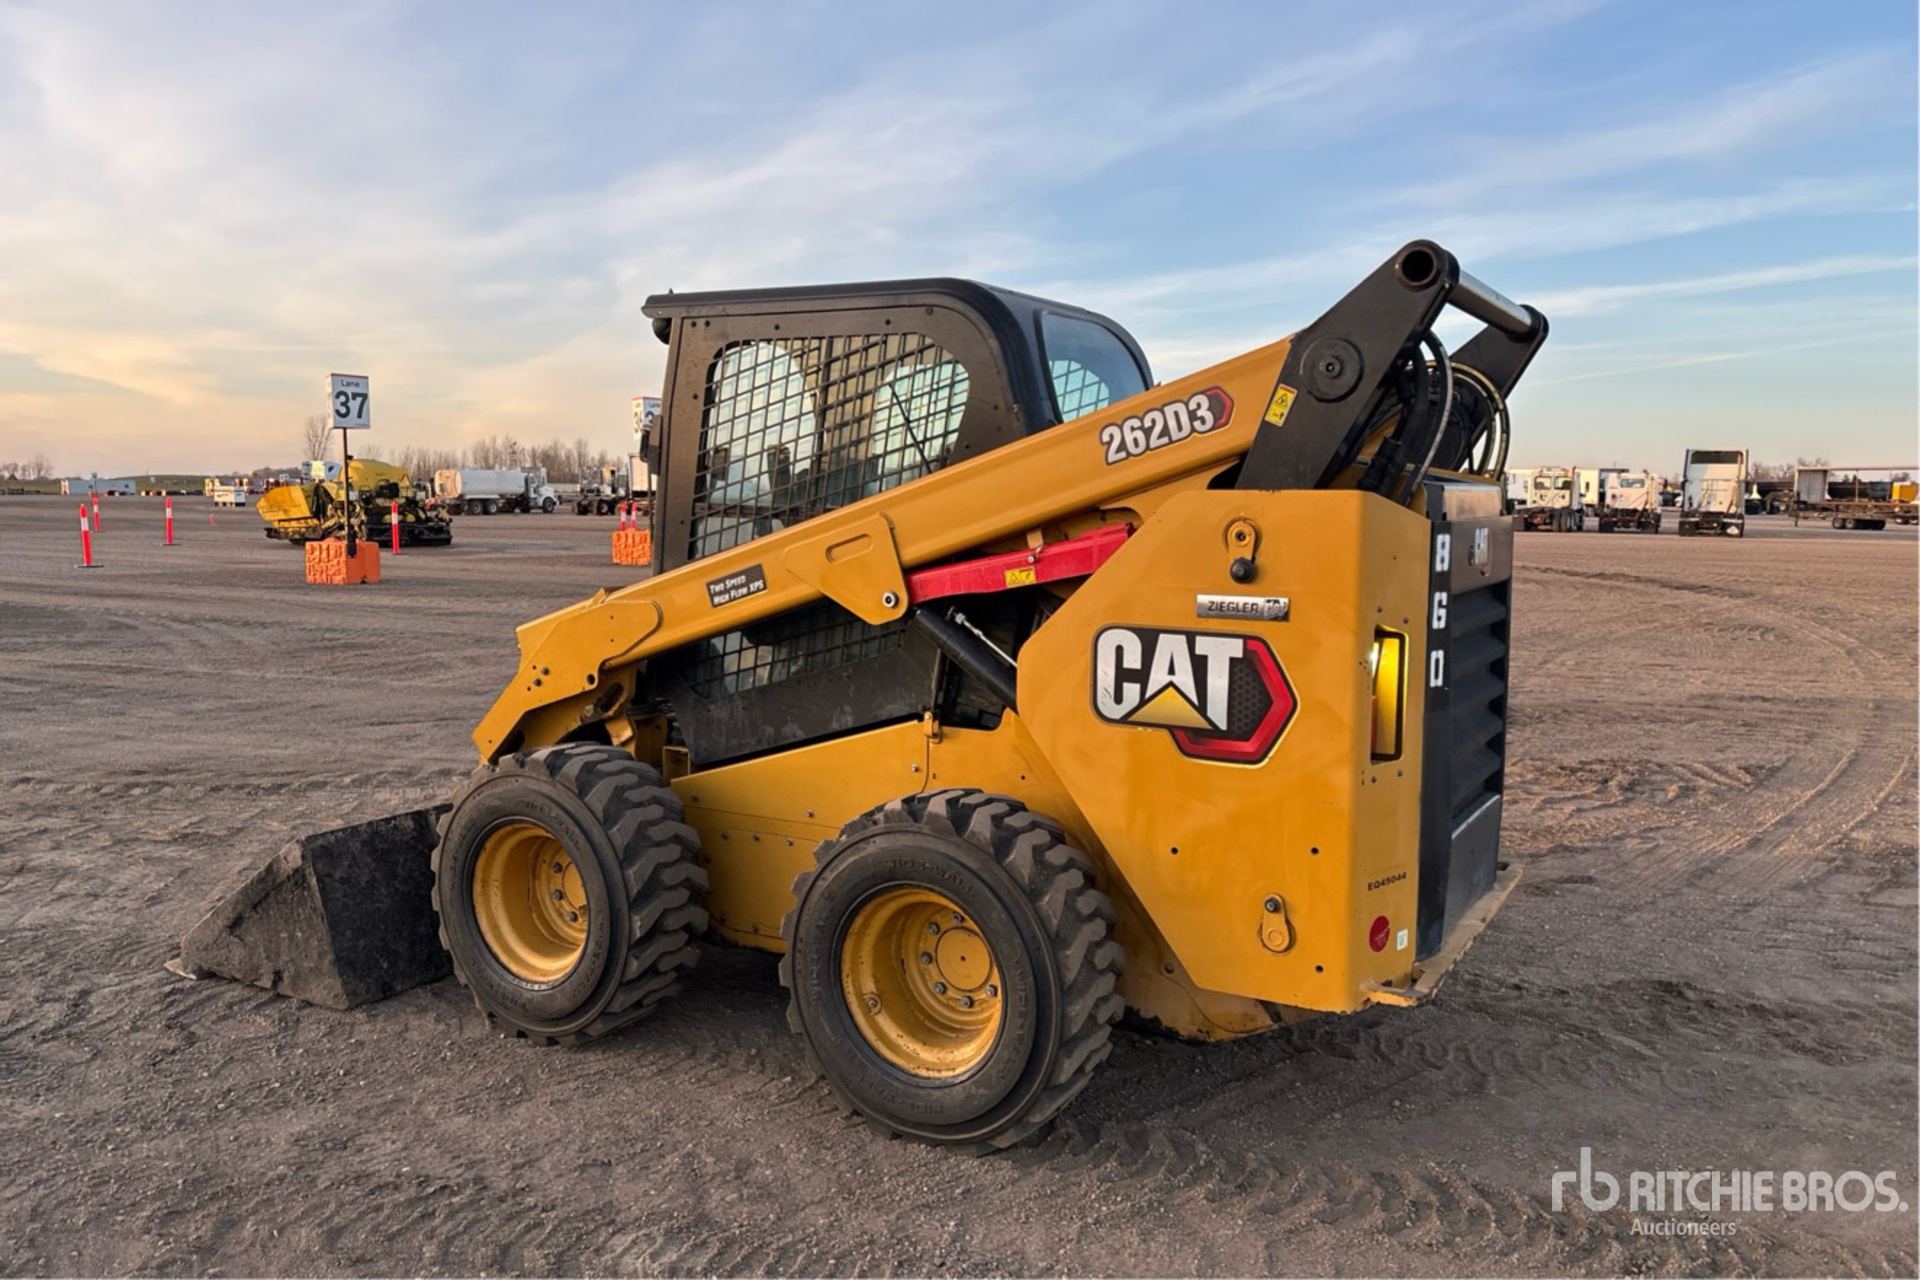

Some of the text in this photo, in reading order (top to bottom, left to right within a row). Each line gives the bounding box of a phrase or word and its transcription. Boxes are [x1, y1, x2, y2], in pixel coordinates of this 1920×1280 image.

[341, 379, 360, 388] Lane
[335, 390, 368, 419] 37
[1102, 394, 1214, 464] 262D3
[749, 579, 765, 593] XPS
[1207, 600, 1260, 614] ZIEGLER
[1097, 629, 1243, 731] CAT
